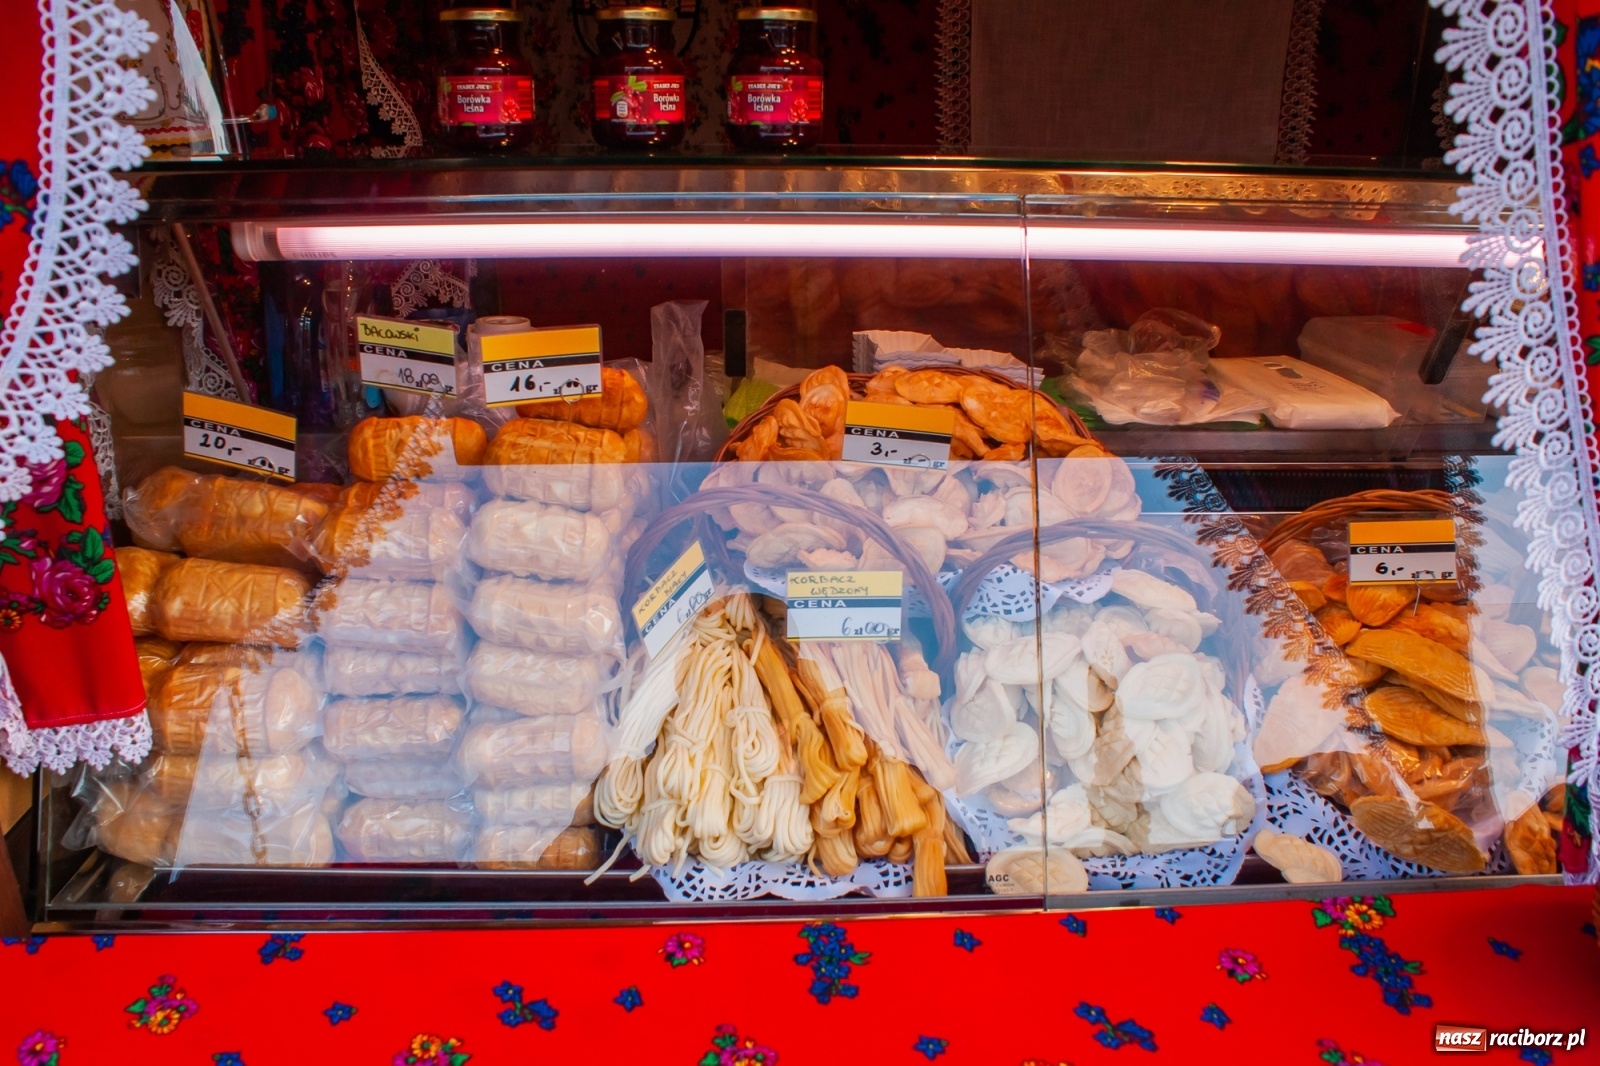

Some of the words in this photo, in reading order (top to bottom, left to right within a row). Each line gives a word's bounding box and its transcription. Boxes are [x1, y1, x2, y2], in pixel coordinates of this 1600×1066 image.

[457, 95, 491, 104] Borówka
[653, 93, 680, 102] Borówka
[747, 94, 781, 103] Borówka
[464, 104, 484, 112] leśna
[660, 102, 676, 111] leśna
[753, 103, 774, 112] leśna
[363, 345, 408, 358] CENA
[491, 360, 545, 372] CENA
[190, 420, 241, 437] CENA
[851, 428, 899, 438] CENA
[1356, 546, 1404, 554] CENA
[789, 575, 856, 585] KORBACZ
[793, 599, 847, 608] CENA
[644, 598, 676, 633] CENA
[989, 874, 1009, 882] AGC
